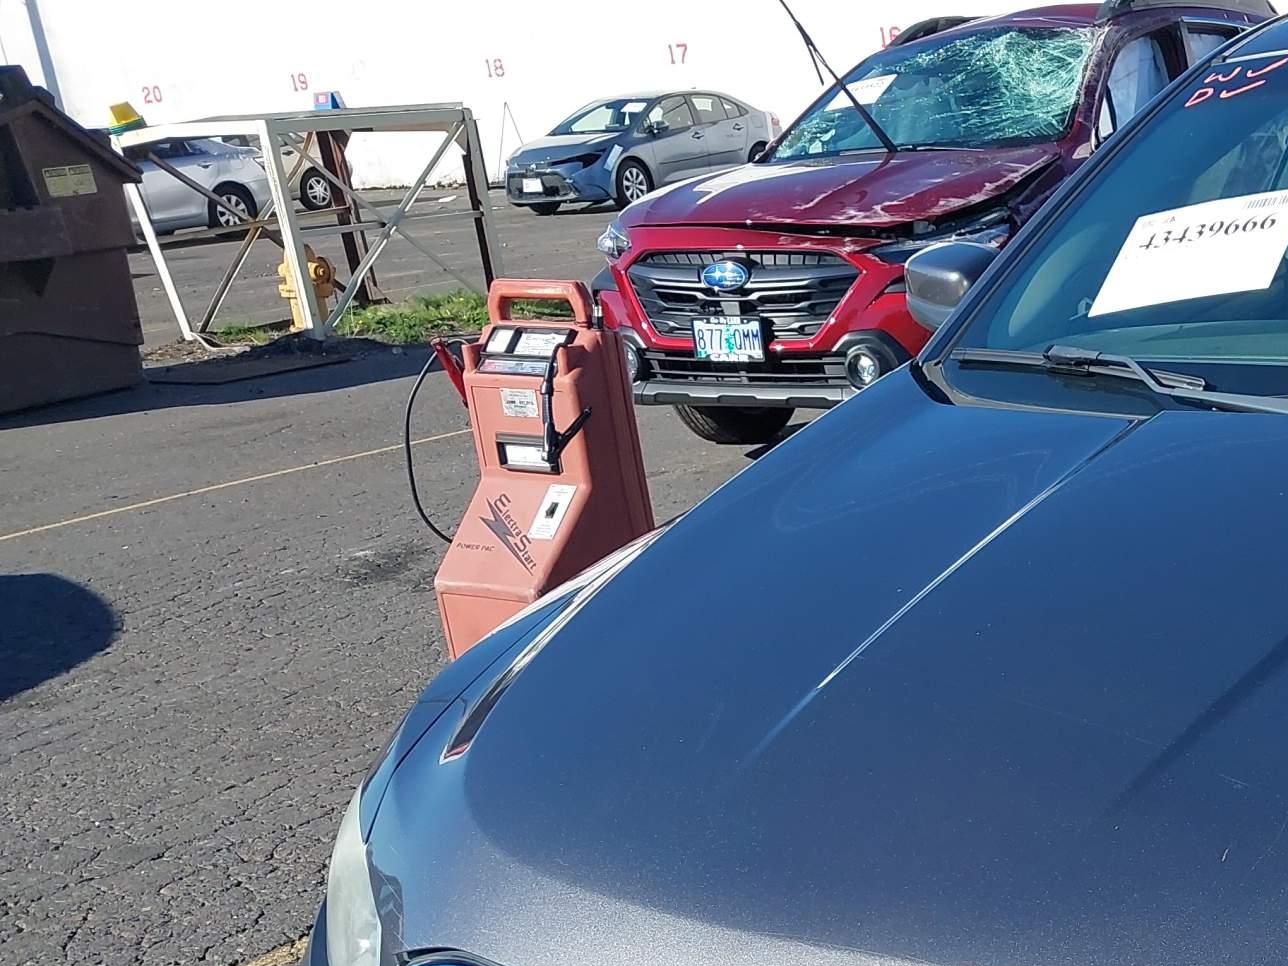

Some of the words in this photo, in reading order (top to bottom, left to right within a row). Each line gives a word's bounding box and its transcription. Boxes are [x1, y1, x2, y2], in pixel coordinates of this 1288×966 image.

[668, 43, 688, 64] 17
[486, 58, 505, 78] 18
[291, 72, 309, 92] 19
[142, 85, 163, 104] 20
[1138, 212, 1279, 250] 43439666
[698, 328, 723, 350] 877
[456, 542, 480, 551] POWER
[481, 544, 496, 552] PAC
